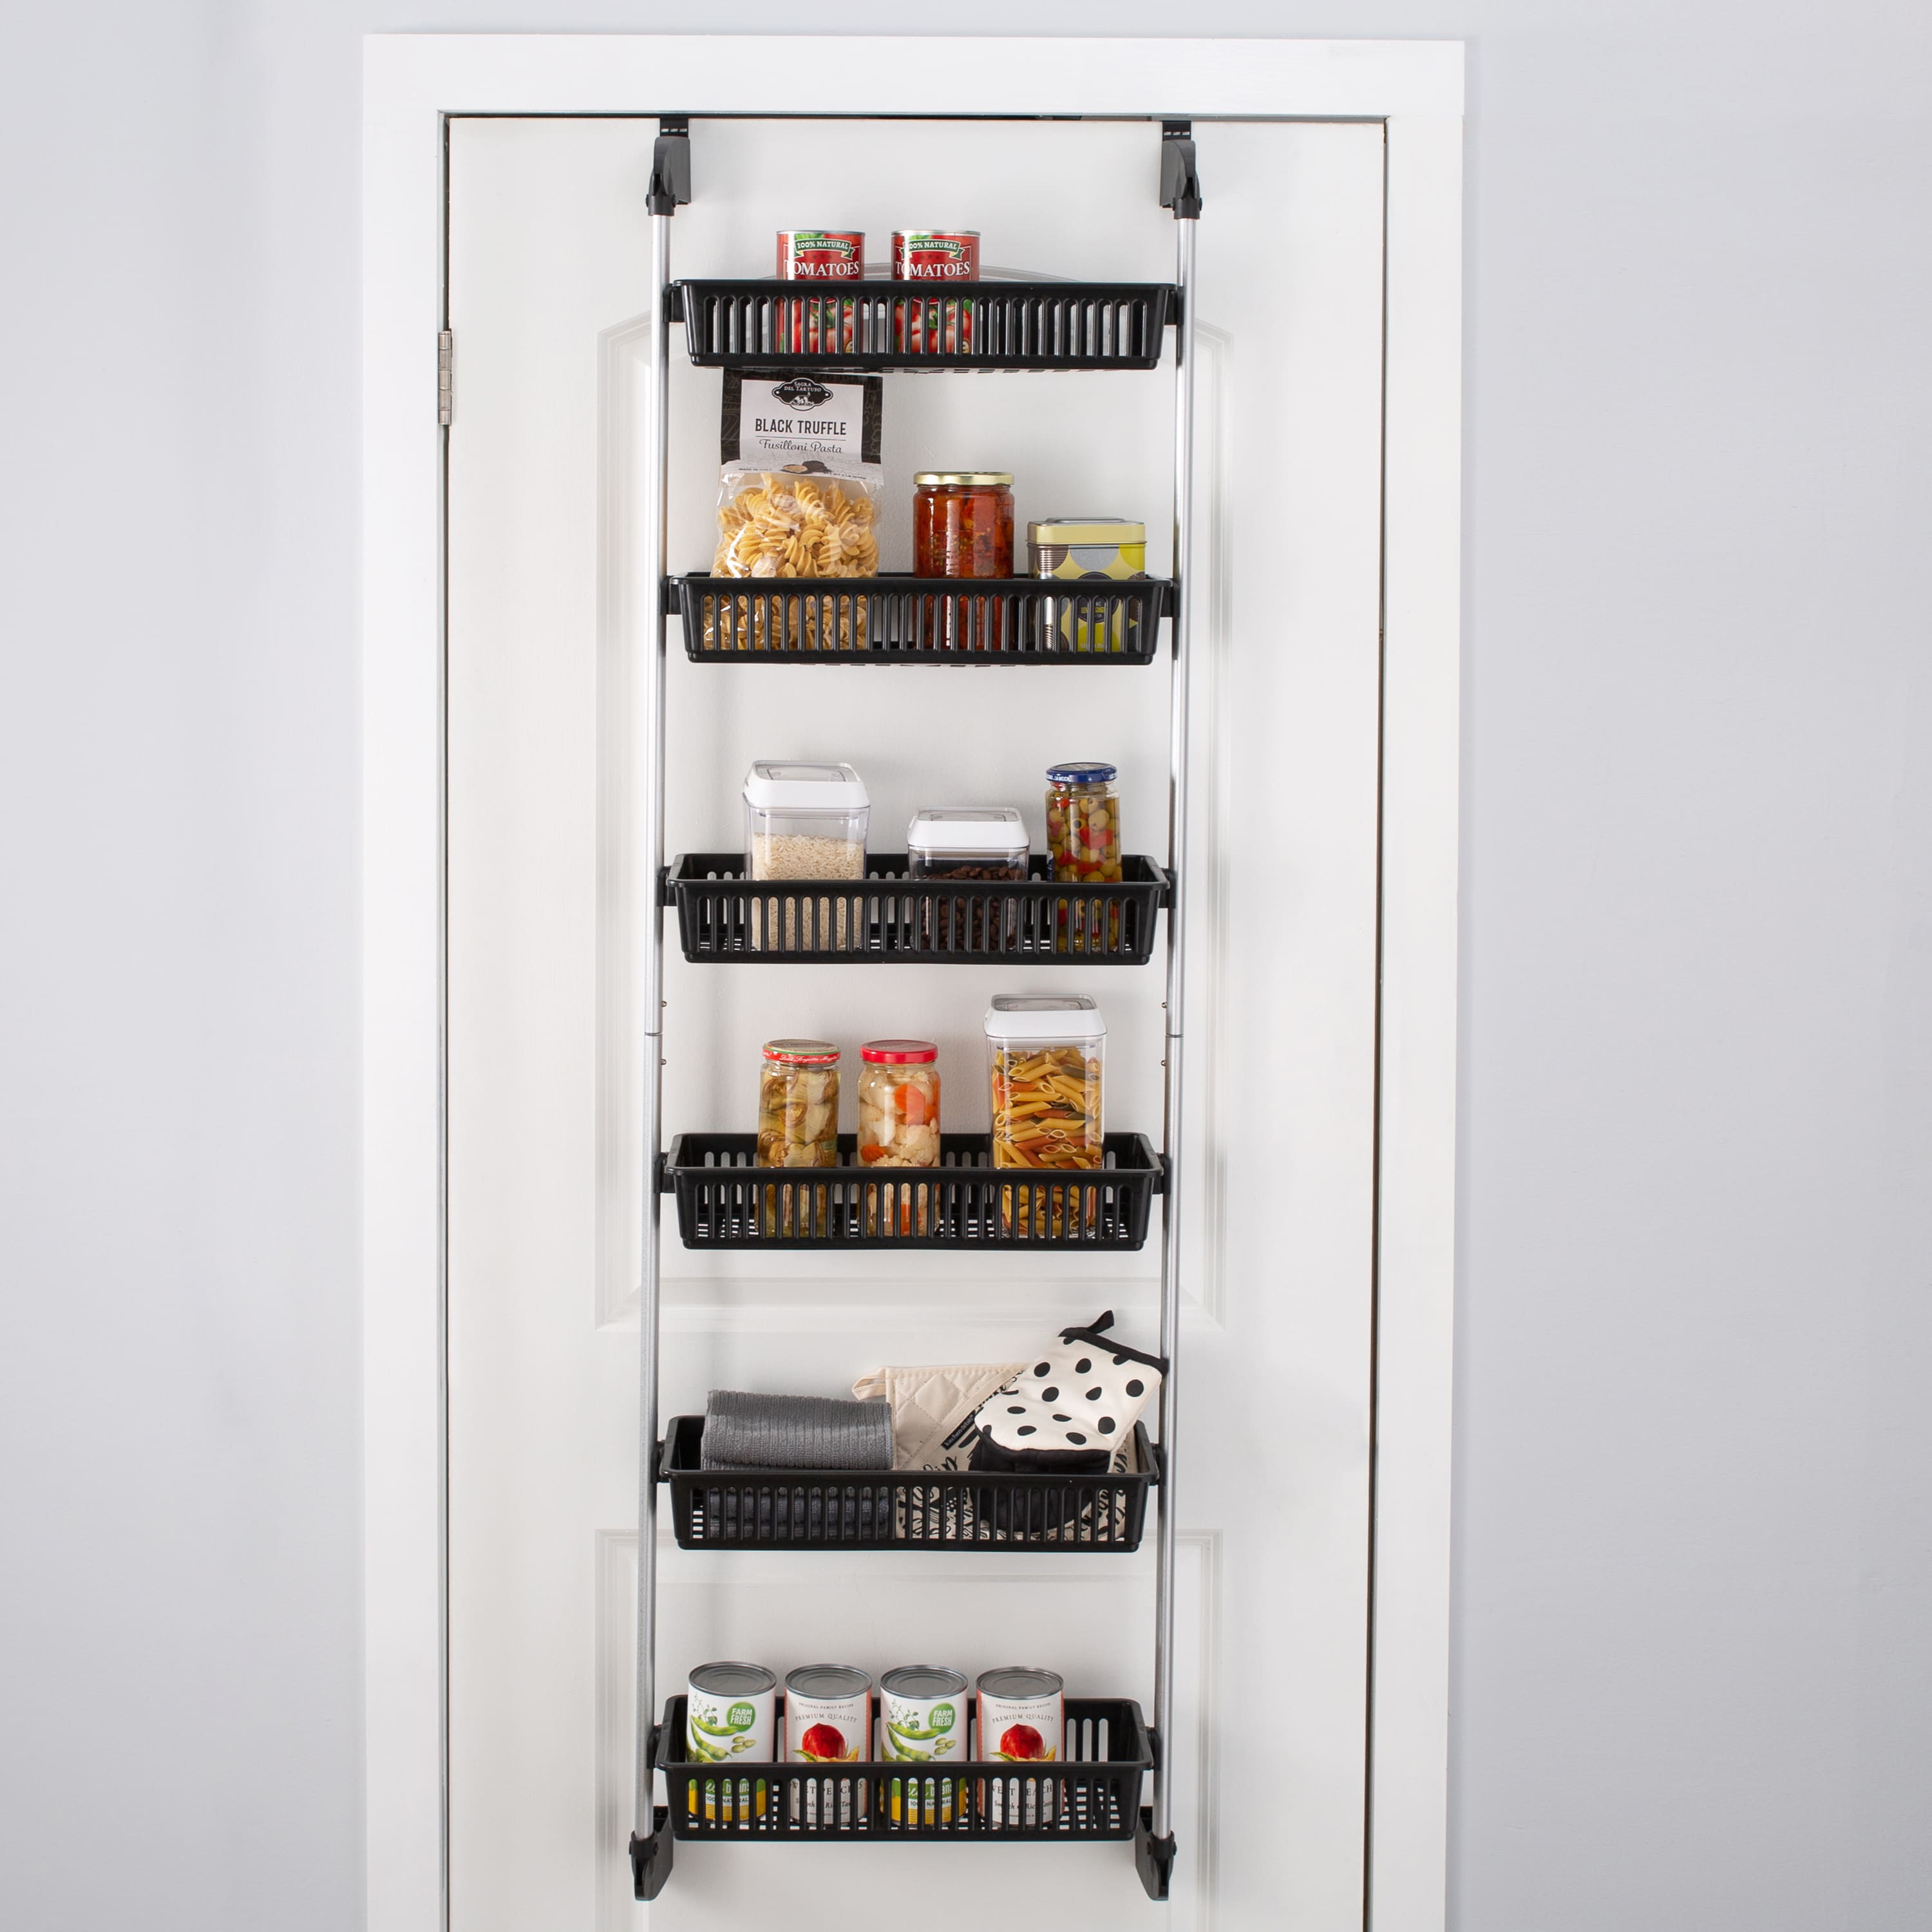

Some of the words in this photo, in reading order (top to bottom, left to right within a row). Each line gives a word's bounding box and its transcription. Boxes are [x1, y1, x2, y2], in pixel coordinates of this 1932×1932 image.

[817, 241, 849, 249] NATURAL
[924, 242, 957, 250] NATURAL
[755, 418, 793, 433] BLACK
[797, 420, 847, 435] TRUFFLE
[759, 438, 808, 452] Fusilloni
[810, 440, 844, 454] Pasta
[730, 1714, 752, 1725] FRESH
[828, 1713, 857, 1723] QUALITY
[932, 1717, 952, 1726] FRESH
[992, 1714, 1023, 1723] PREMIUM
[1026, 1713, 1054, 1722] QUALITY
